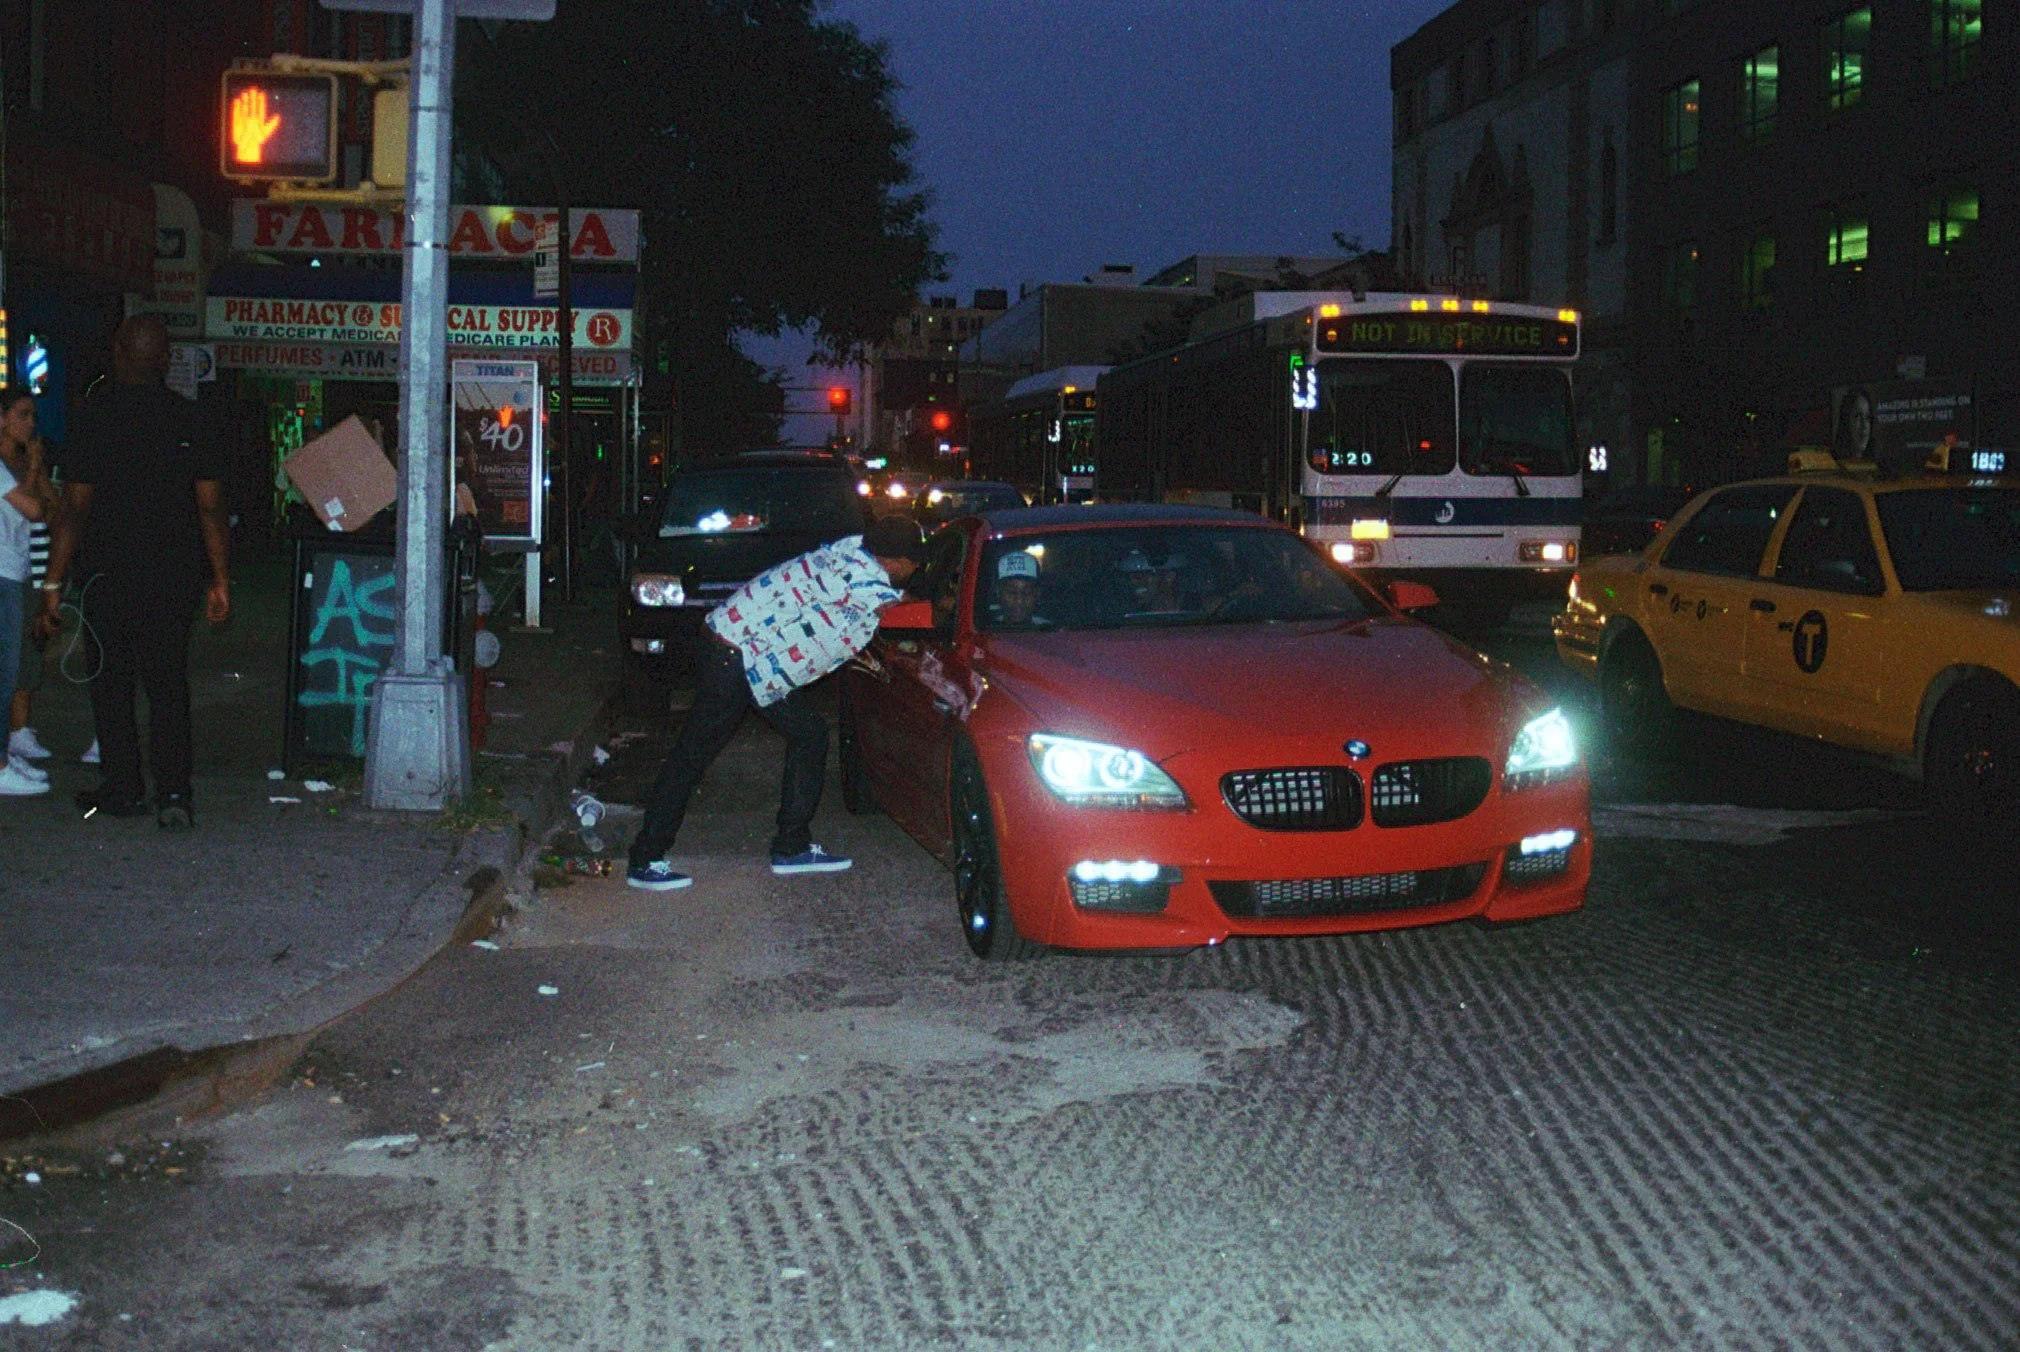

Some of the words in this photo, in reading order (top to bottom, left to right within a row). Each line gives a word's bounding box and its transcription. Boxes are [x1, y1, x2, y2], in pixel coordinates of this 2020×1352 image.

[253, 204, 616, 257] FARACA
[224, 300, 348, 326] PHARMACY
[232, 326, 258, 337] WE
[262, 326, 326, 338] ACCEPT
[447, 333, 514, 346] EDICARE
[1351, 322, 1397, 343] NOT
[1407, 322, 1431, 343] IN
[1440, 322, 1541, 345] SERVICE
[215, 344, 323, 366] PERFUMES
[341, 349, 385, 368] ATM
[476, 365, 515, 376] TITAN
[479, 417, 524, 452] $40
